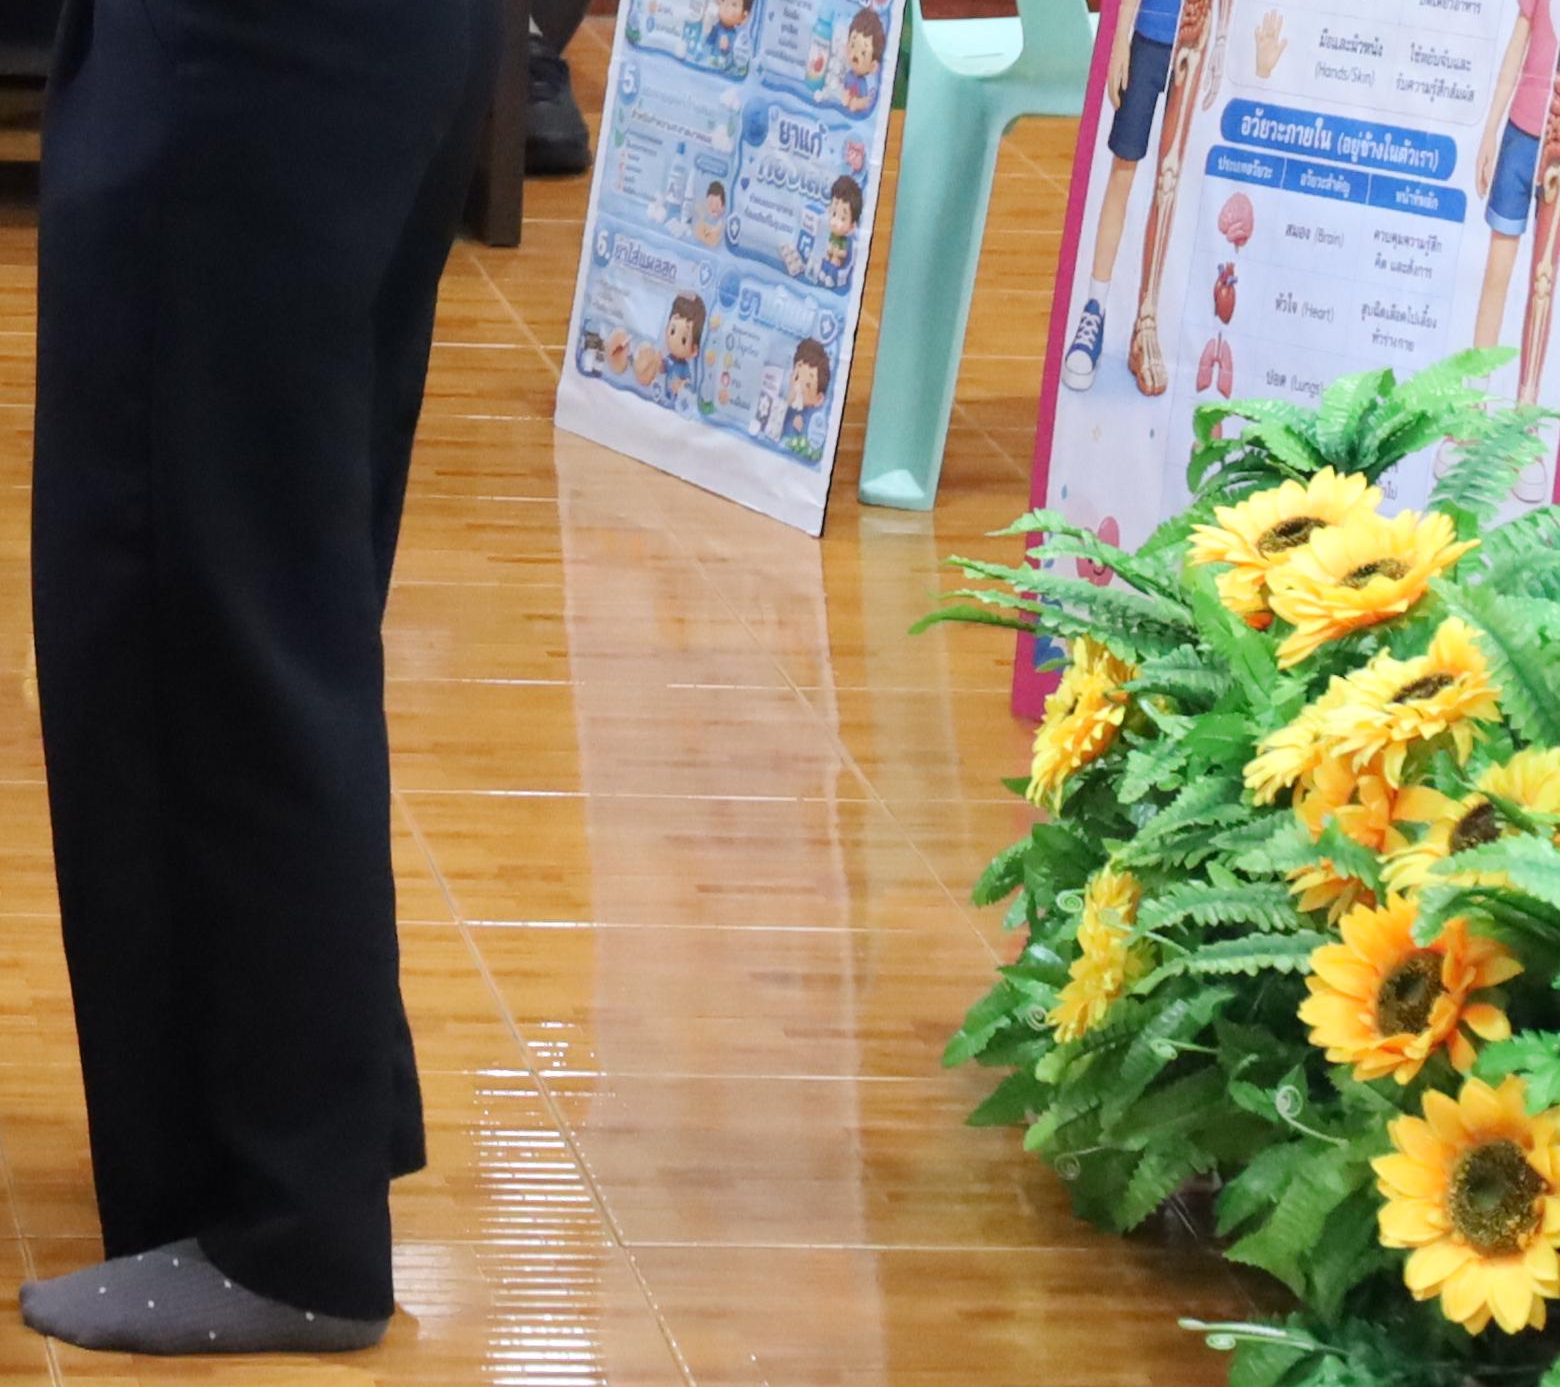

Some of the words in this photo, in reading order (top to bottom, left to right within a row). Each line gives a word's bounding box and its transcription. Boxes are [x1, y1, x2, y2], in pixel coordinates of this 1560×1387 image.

[1315, 61, 1375, 88] (Hands/Skin)
[780, 119, 826, 157] ยาแก้
[1241, 107, 1332, 150] อวัยวะภายใน
[1337, 131, 1439, 172] (อยู่ข้างในตัวเรา)
[1285, 222, 1311, 241] สมอง
[1313, 225, 1345, 249] (Brain)
[1275, 292, 1298, 315] หัวใจ
[1301, 301, 1334, 323] (Heart)
[1266, 369, 1287, 387] ปอด
